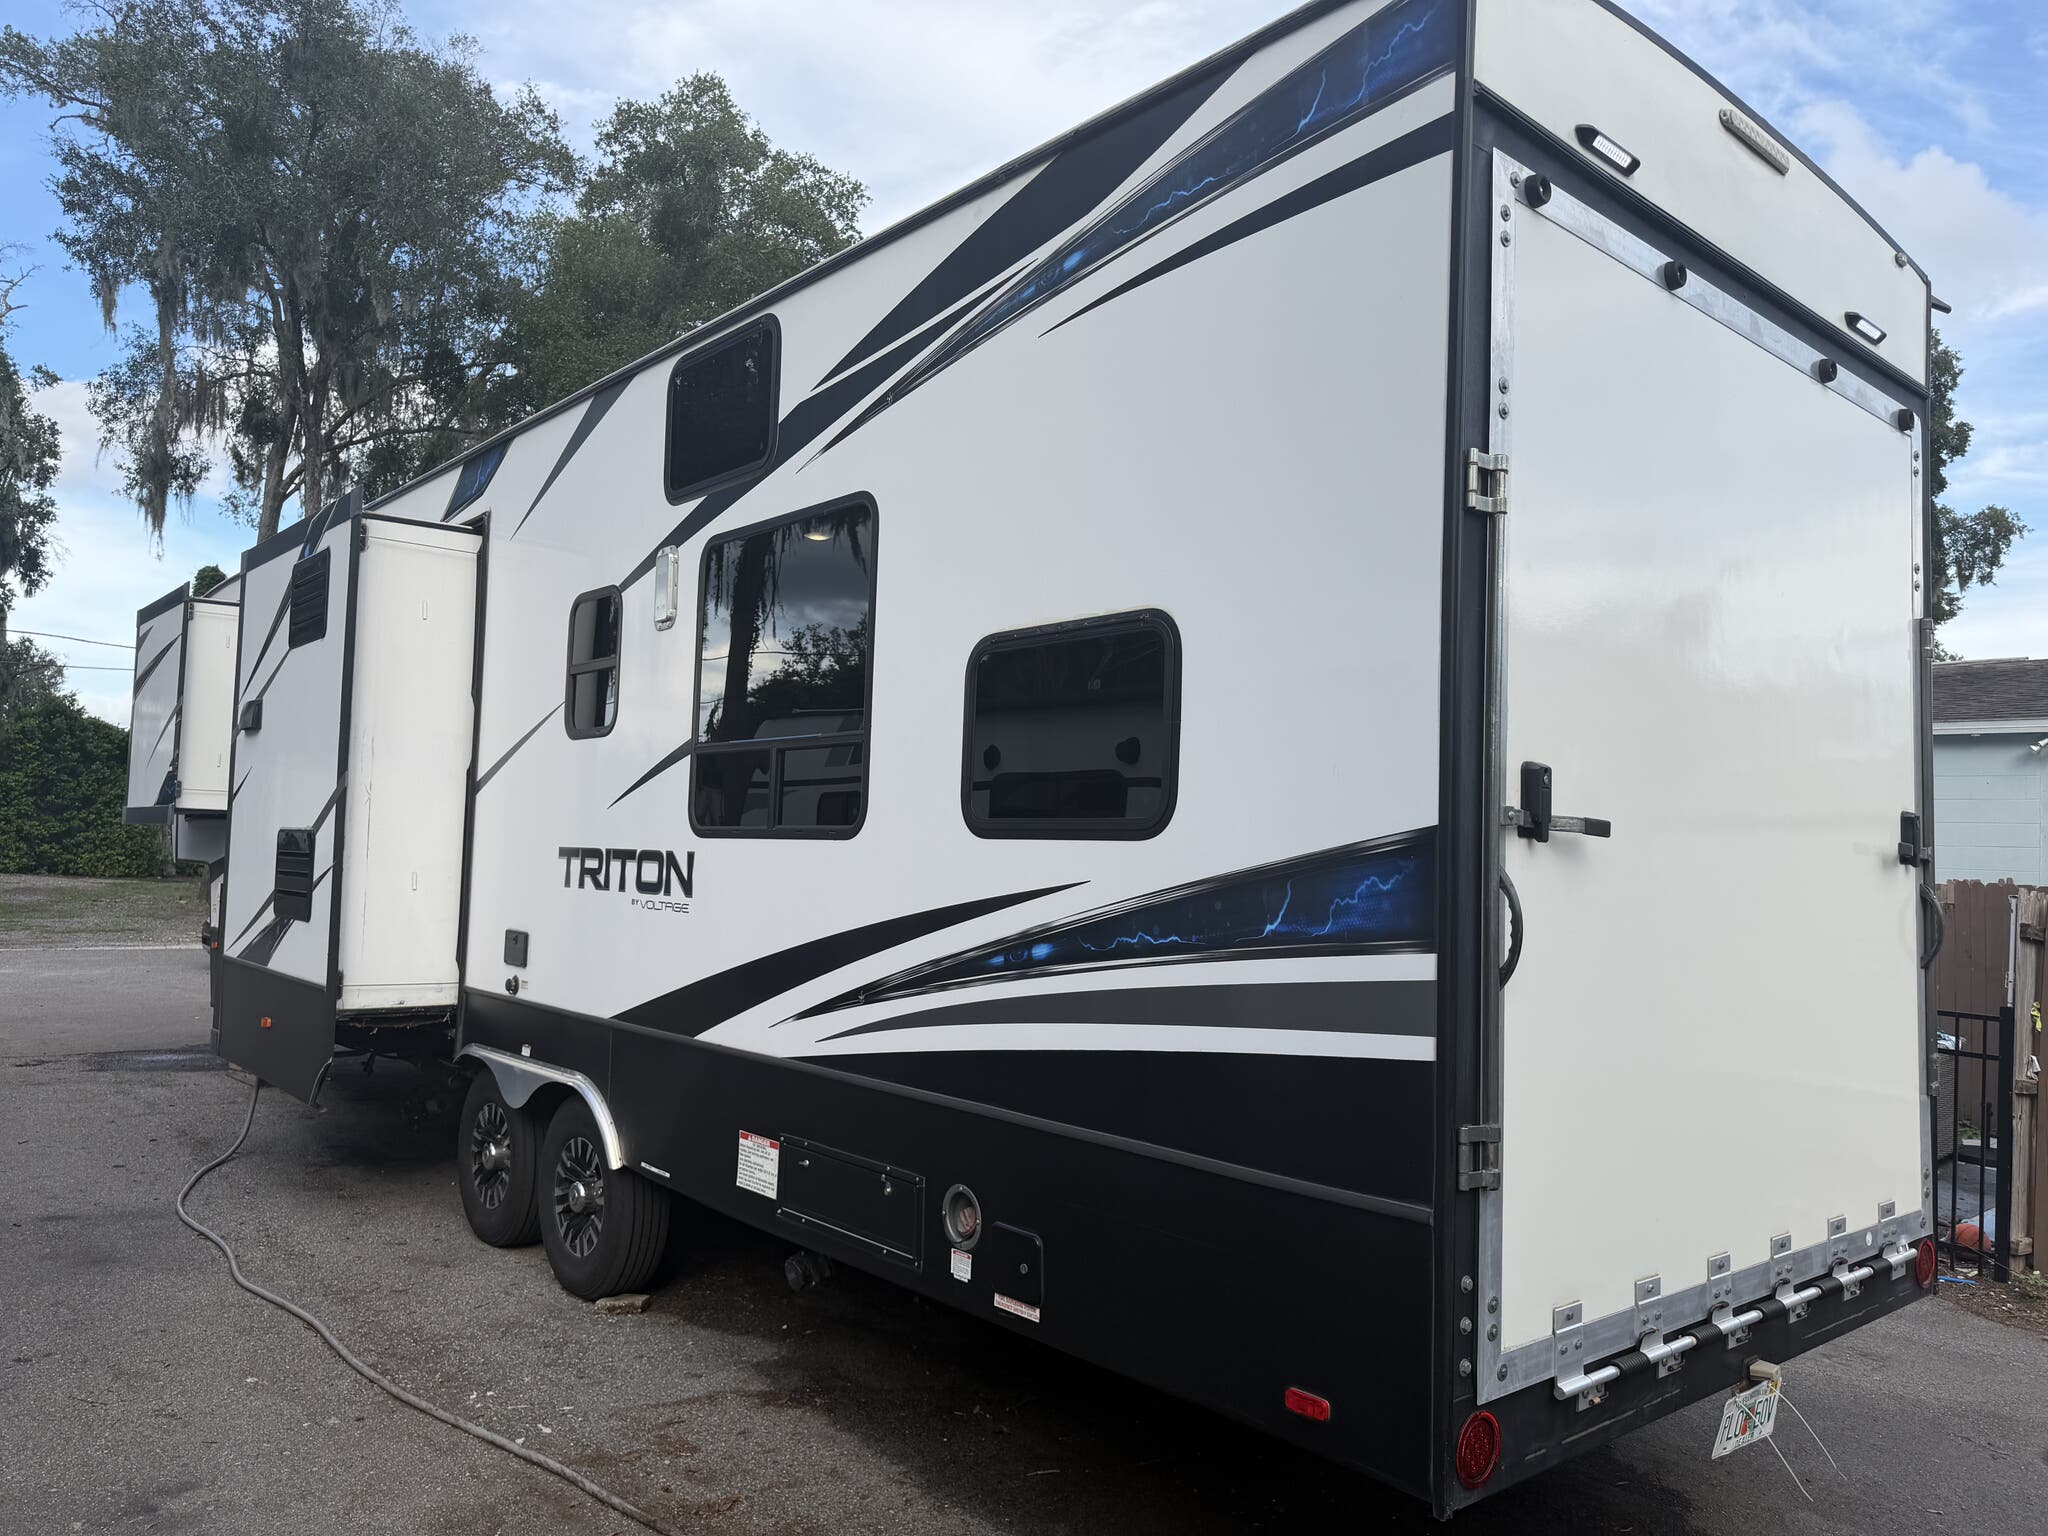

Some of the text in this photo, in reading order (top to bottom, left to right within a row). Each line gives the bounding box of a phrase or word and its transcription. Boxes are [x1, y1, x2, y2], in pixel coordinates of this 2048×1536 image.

[558, 847, 695, 898] TRITON
[631, 898, 690, 914] BY VOLTAGE
